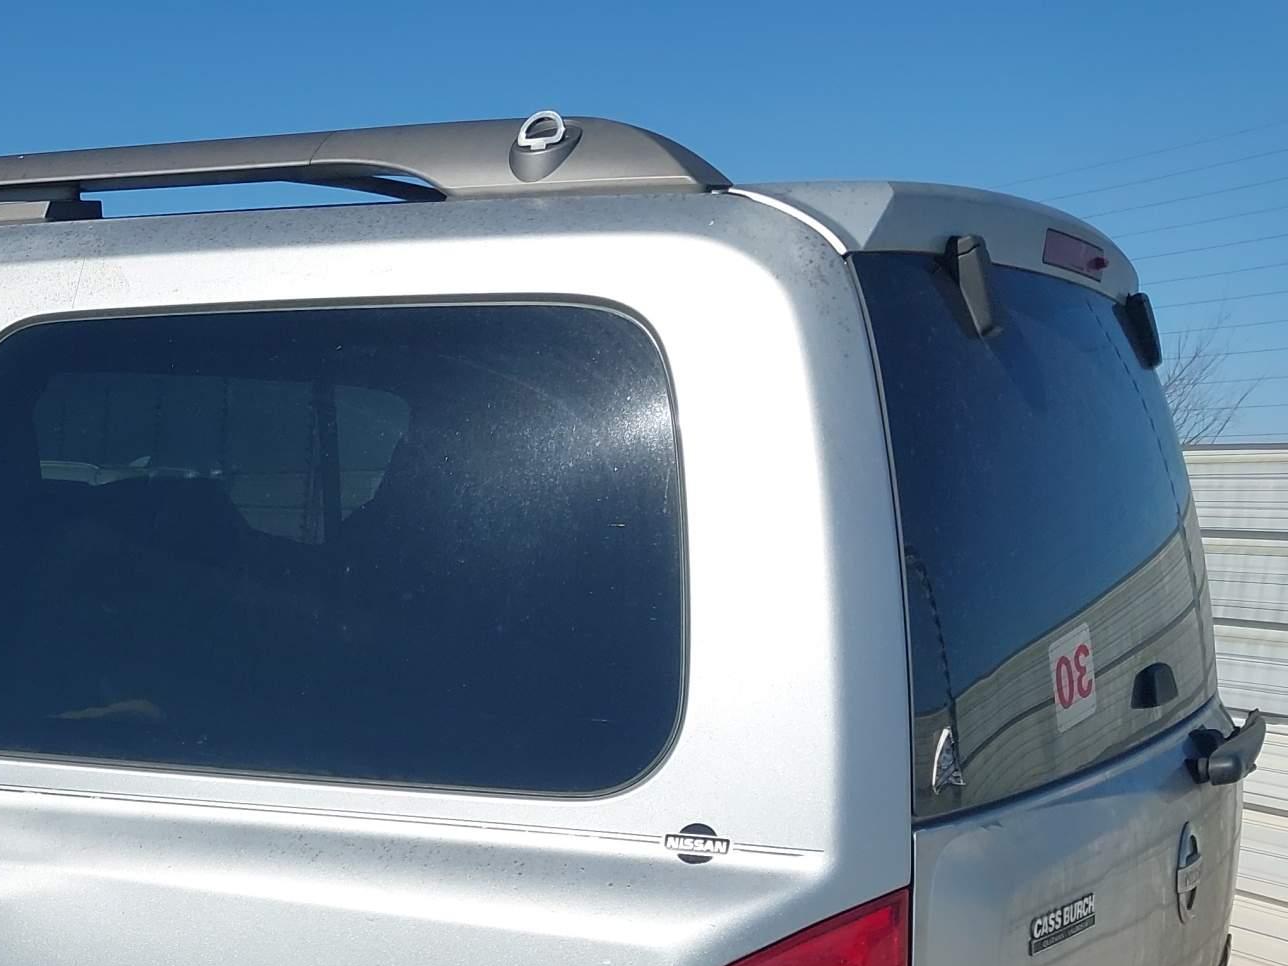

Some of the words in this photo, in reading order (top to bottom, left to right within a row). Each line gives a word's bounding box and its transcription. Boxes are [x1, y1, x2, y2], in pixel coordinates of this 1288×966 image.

[666, 835, 728, 854] NISSAN
[1033, 909, 1062, 938] CASS
[1063, 894, 1096, 926] BURCH
